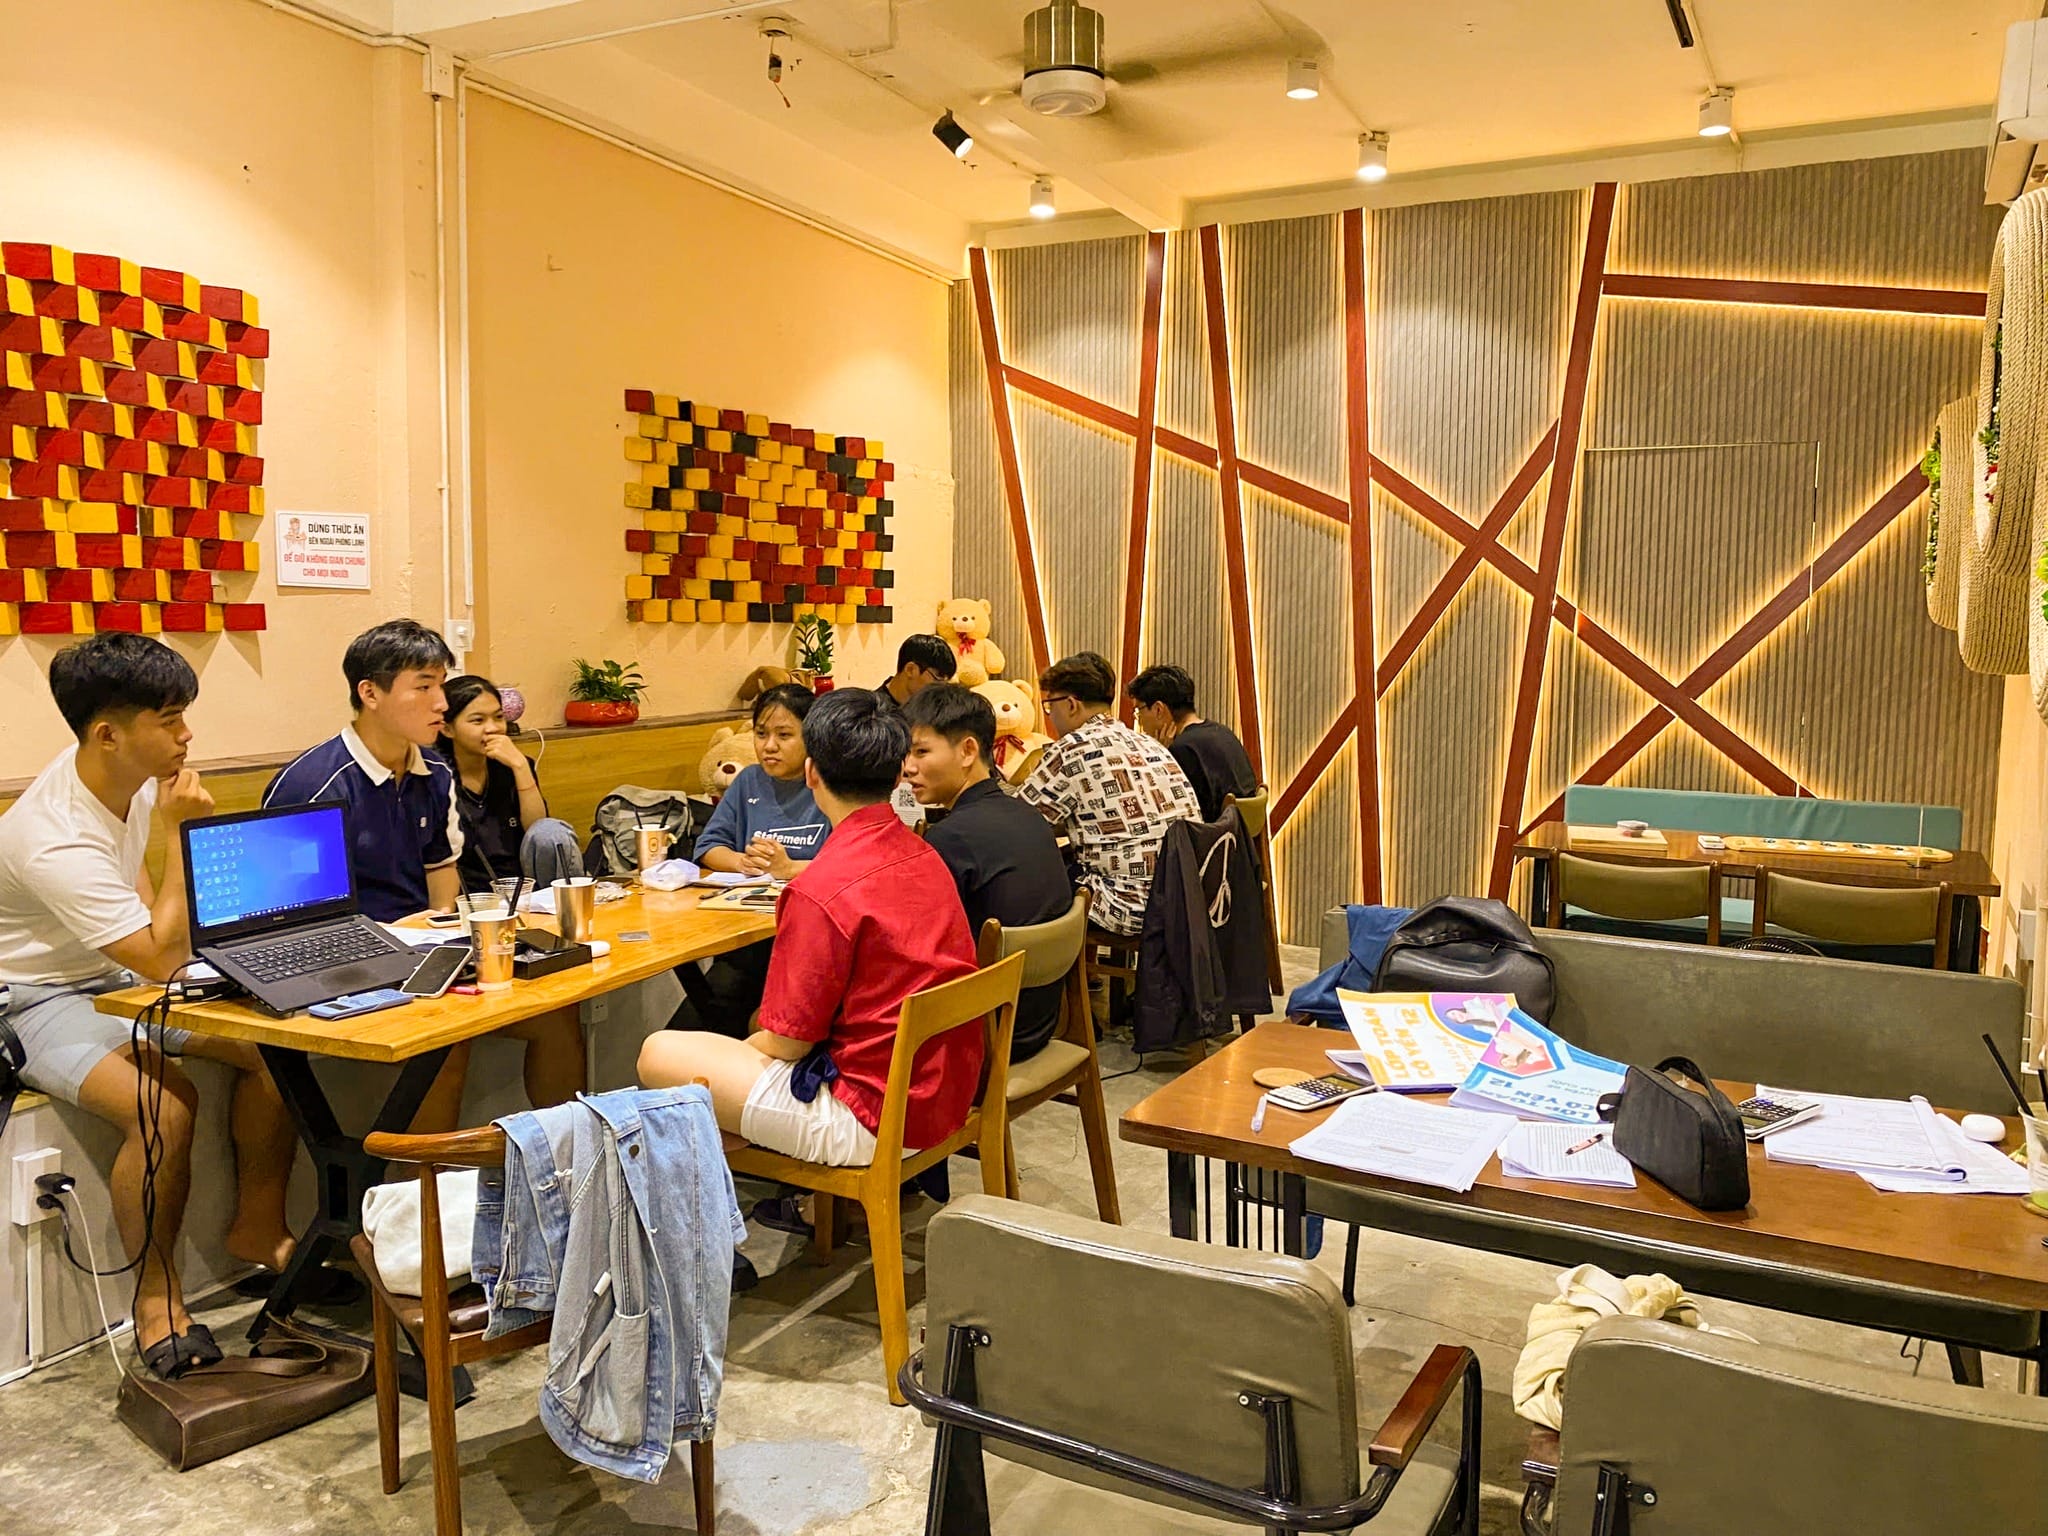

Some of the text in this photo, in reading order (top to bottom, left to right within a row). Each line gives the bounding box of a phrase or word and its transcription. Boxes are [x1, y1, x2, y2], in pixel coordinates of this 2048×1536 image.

[353, 523, 364, 535] ĂN
[303, 568, 316, 576] CHO
[1401, 1008, 1421, 1026] 12
[1489, 1077, 1513, 1089] 12
